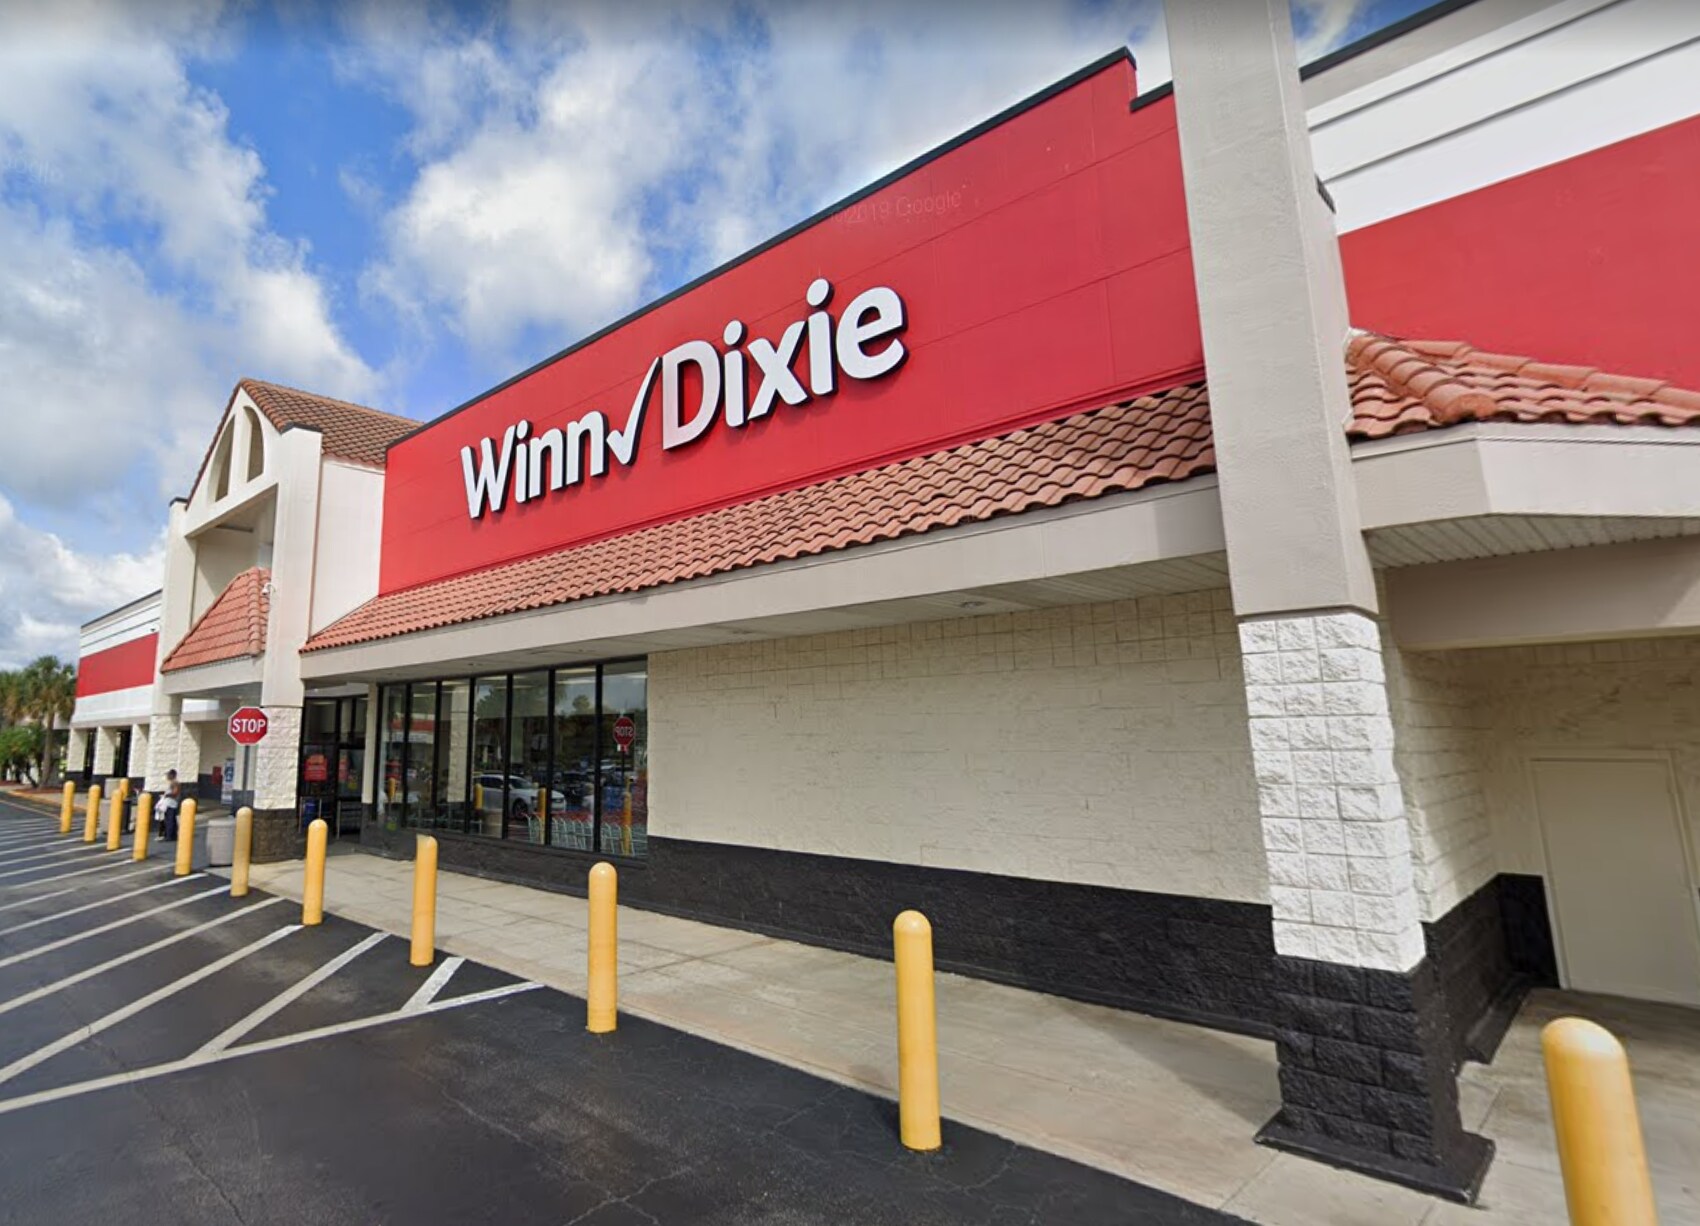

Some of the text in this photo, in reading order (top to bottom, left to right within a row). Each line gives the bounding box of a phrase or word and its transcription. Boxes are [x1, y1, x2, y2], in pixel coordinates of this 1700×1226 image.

[460, 278, 908, 519] Winn Dixie
[232, 718, 266, 733] STOP
